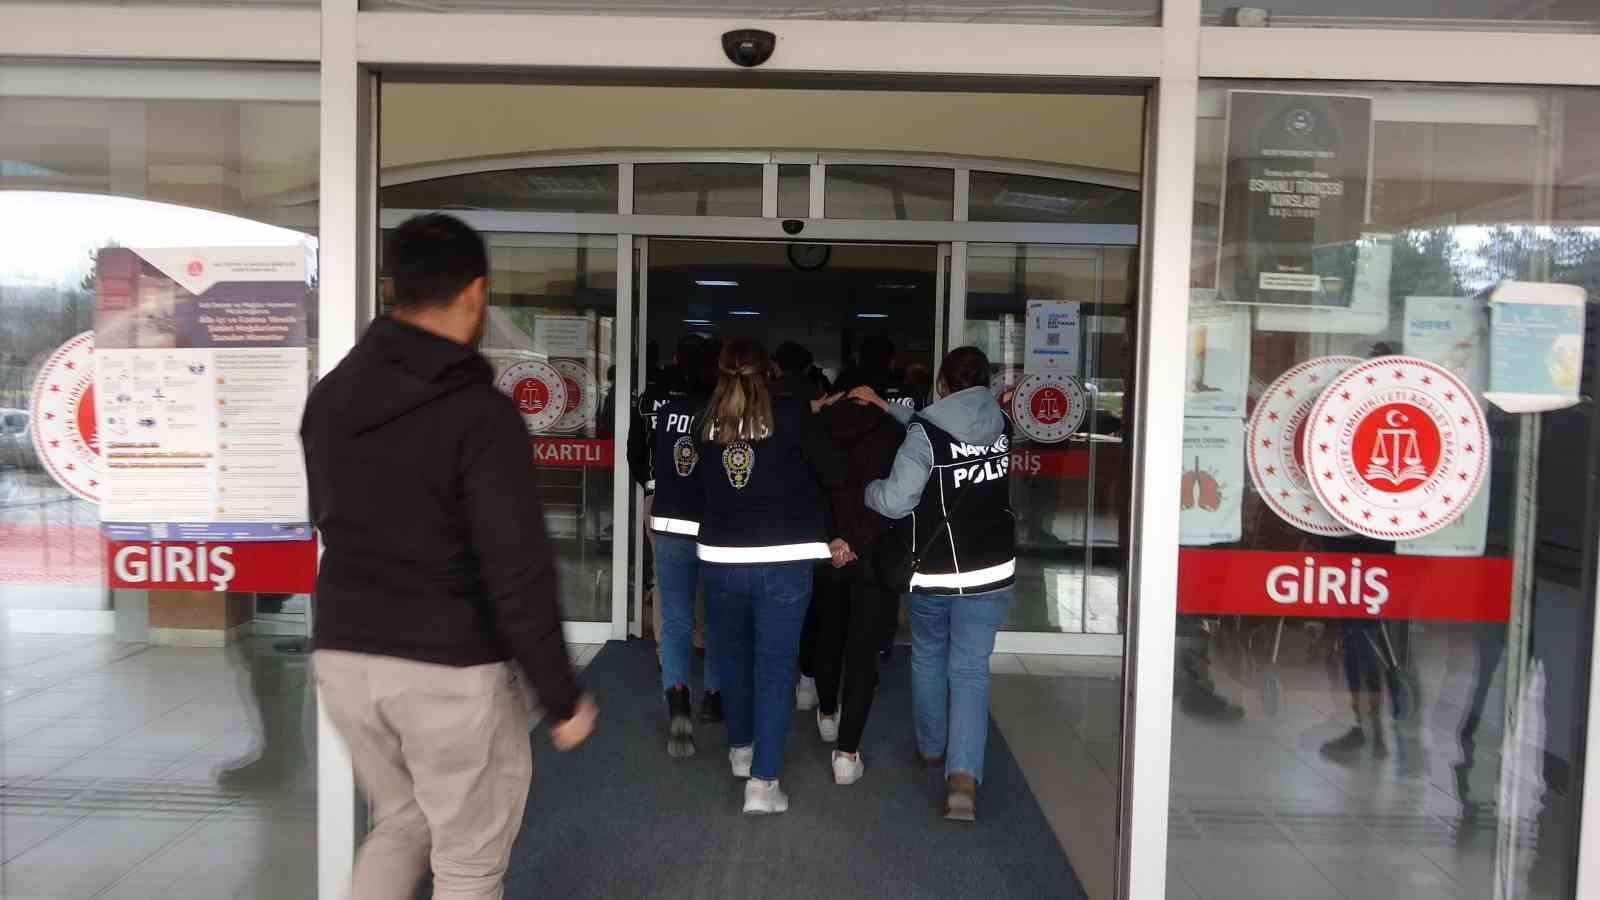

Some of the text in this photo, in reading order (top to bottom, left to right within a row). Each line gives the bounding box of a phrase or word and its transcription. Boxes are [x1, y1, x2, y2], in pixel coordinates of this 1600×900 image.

[534, 444, 600, 461] KARTLI
[114, 540, 236, 592] GİRİŞ
[1265, 556, 1389, 615] GİRİŞ
